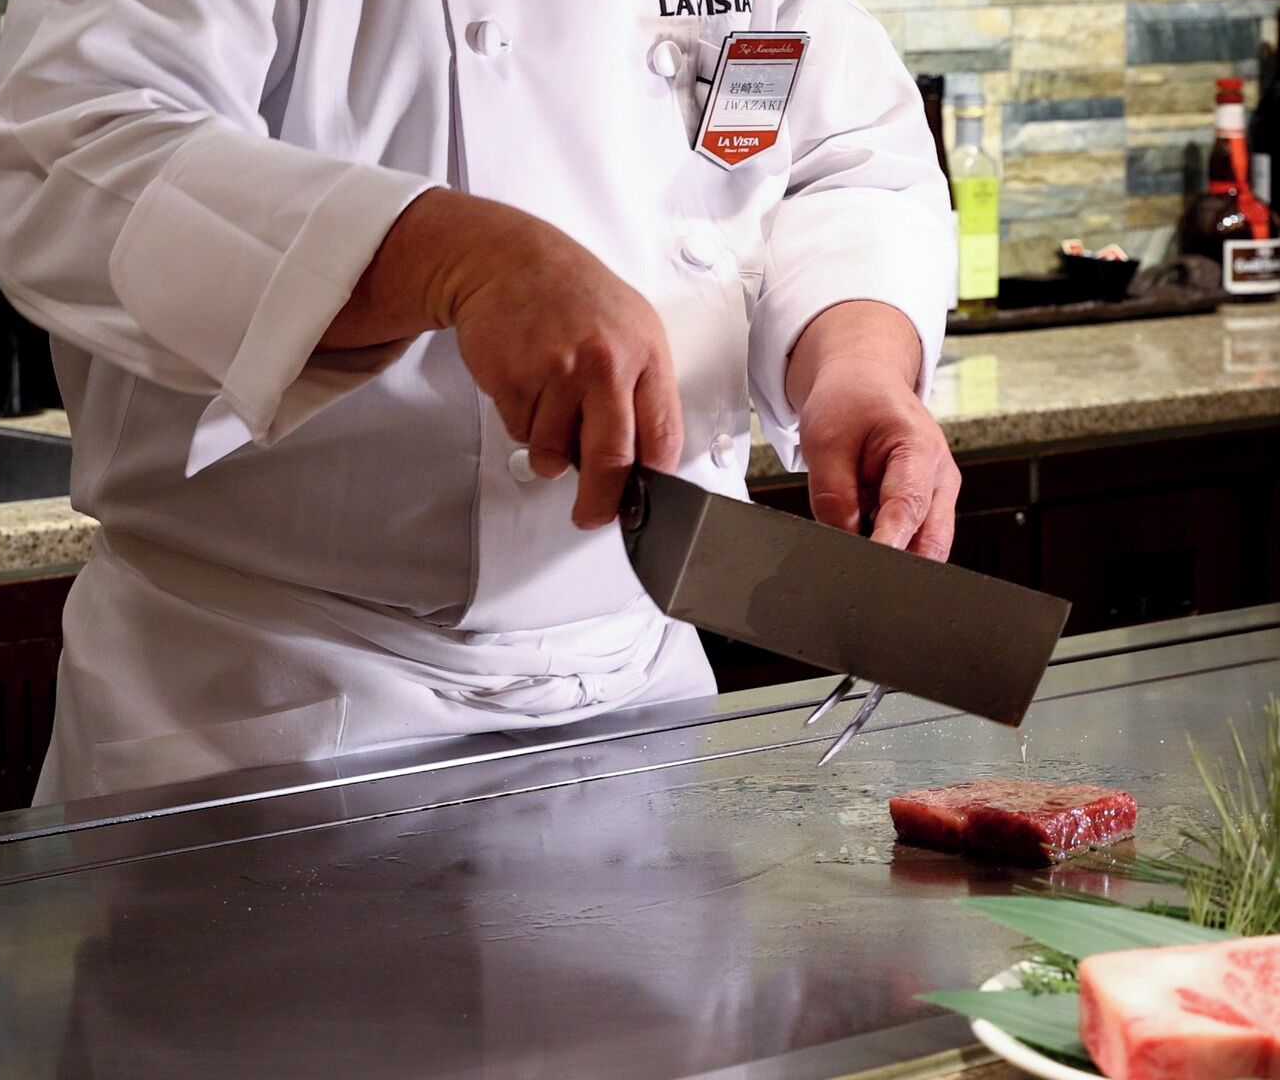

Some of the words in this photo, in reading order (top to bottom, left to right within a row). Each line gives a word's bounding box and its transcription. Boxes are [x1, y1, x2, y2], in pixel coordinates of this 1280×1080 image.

[724, 100, 784, 111] IWAZAKI
[717, 136, 730, 147] LA
[732, 135, 760, 147] VISTA
